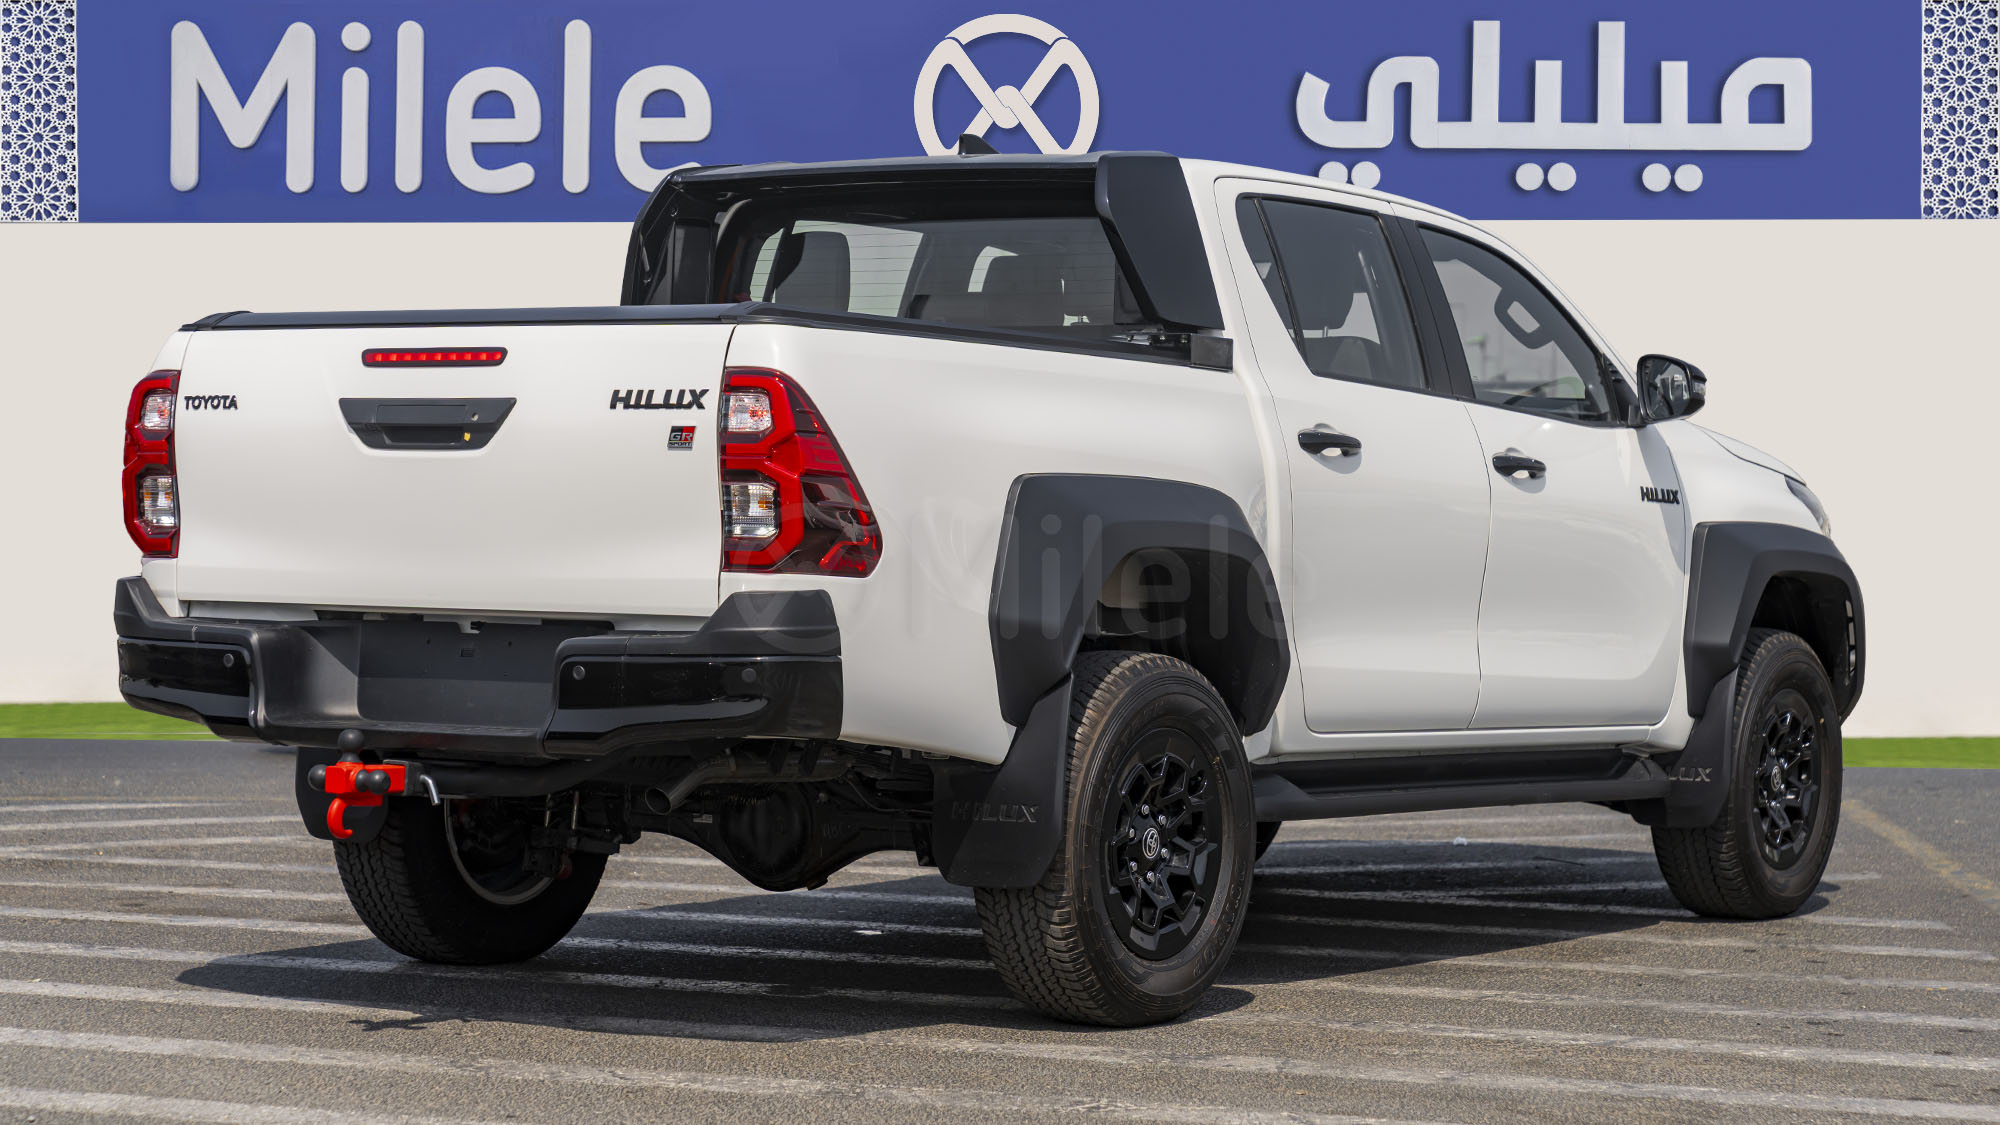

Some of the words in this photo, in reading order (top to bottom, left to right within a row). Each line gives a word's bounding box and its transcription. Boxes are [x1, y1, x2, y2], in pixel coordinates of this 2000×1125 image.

[170, 19, 712, 194] Milele
[1296, 20, 1812, 192] ميليلي
[184, 395, 238, 410] TOYOTA
[609, 389, 709, 409] HILUX
[670, 432, 693, 441] GR
[1640, 486, 1680, 504] HILUX
[1668, 767, 1712, 782] LUX
[951, 802, 1039, 823] HILUX
